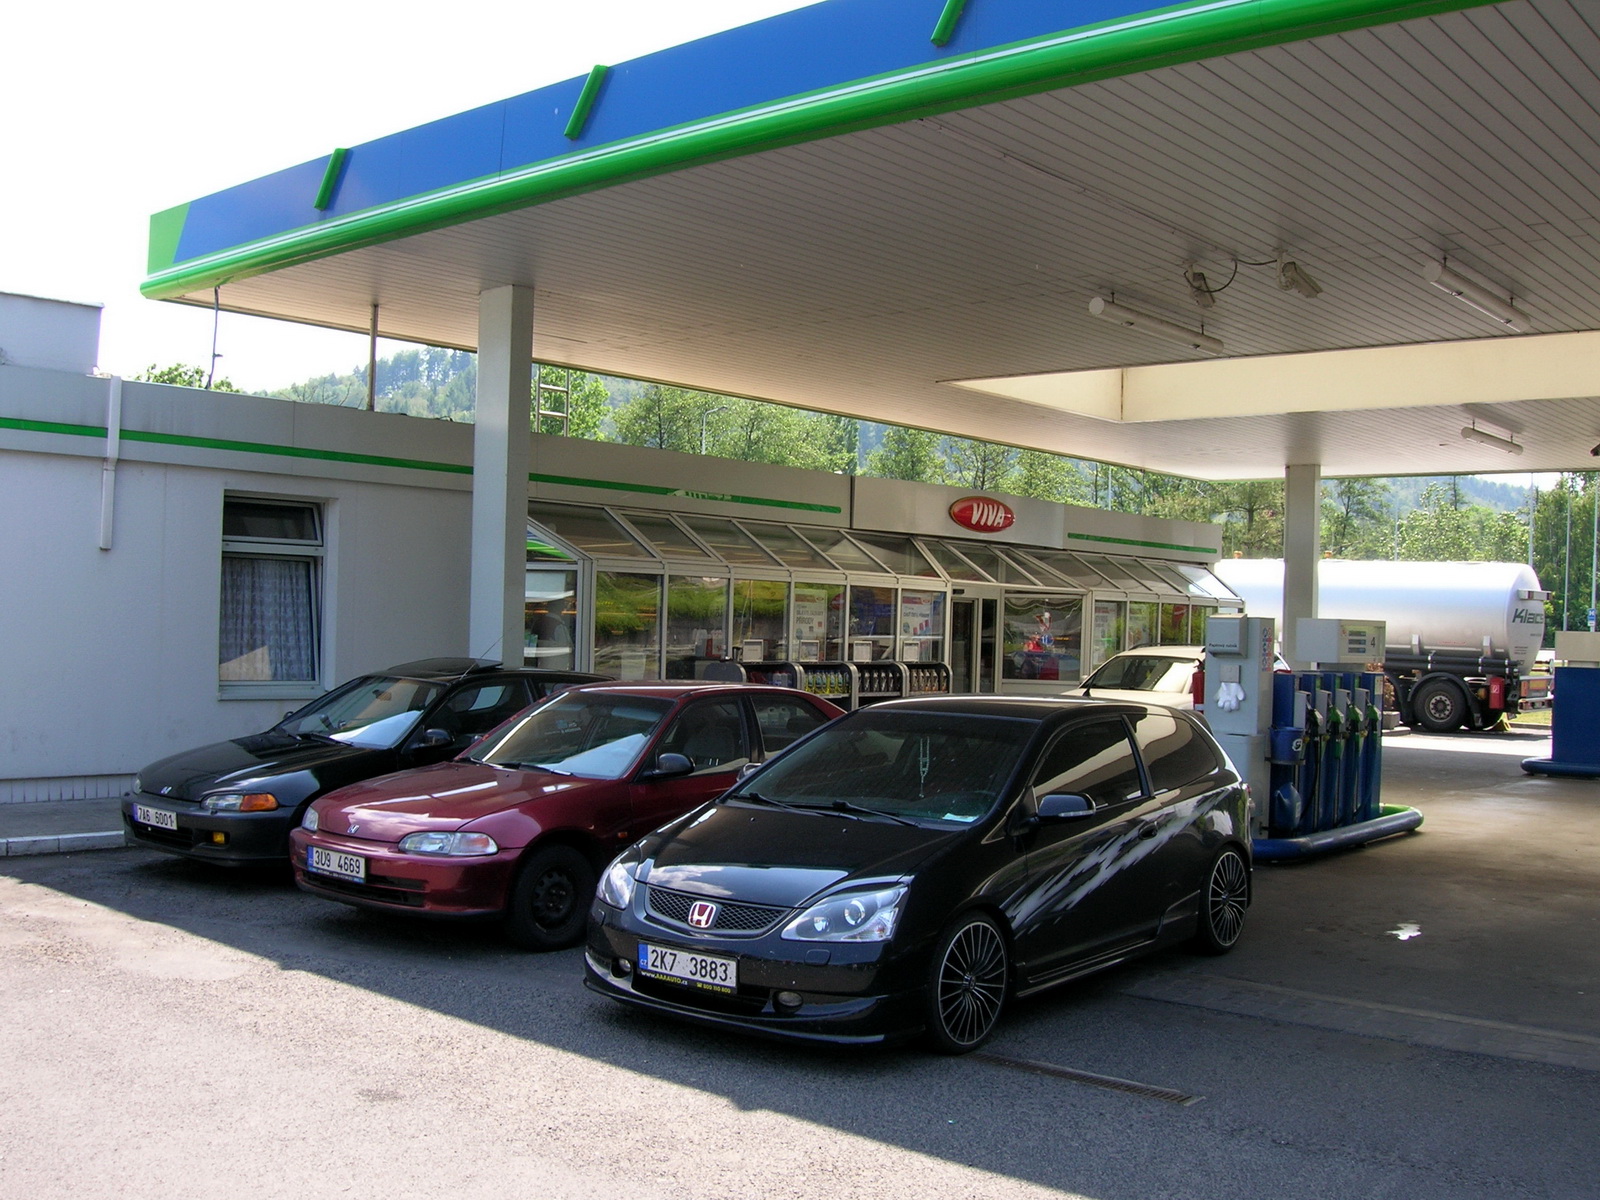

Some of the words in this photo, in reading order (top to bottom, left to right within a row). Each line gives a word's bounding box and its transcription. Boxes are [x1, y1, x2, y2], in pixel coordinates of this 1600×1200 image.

[971, 502, 1005, 527] VIVA
[1370, 636, 1376, 648] 4
[138, 807, 150, 822] 7A6
[337, 855, 361, 874] 4669
[651, 949, 677, 972] 2K7
[690, 957, 728, 982] 3883
